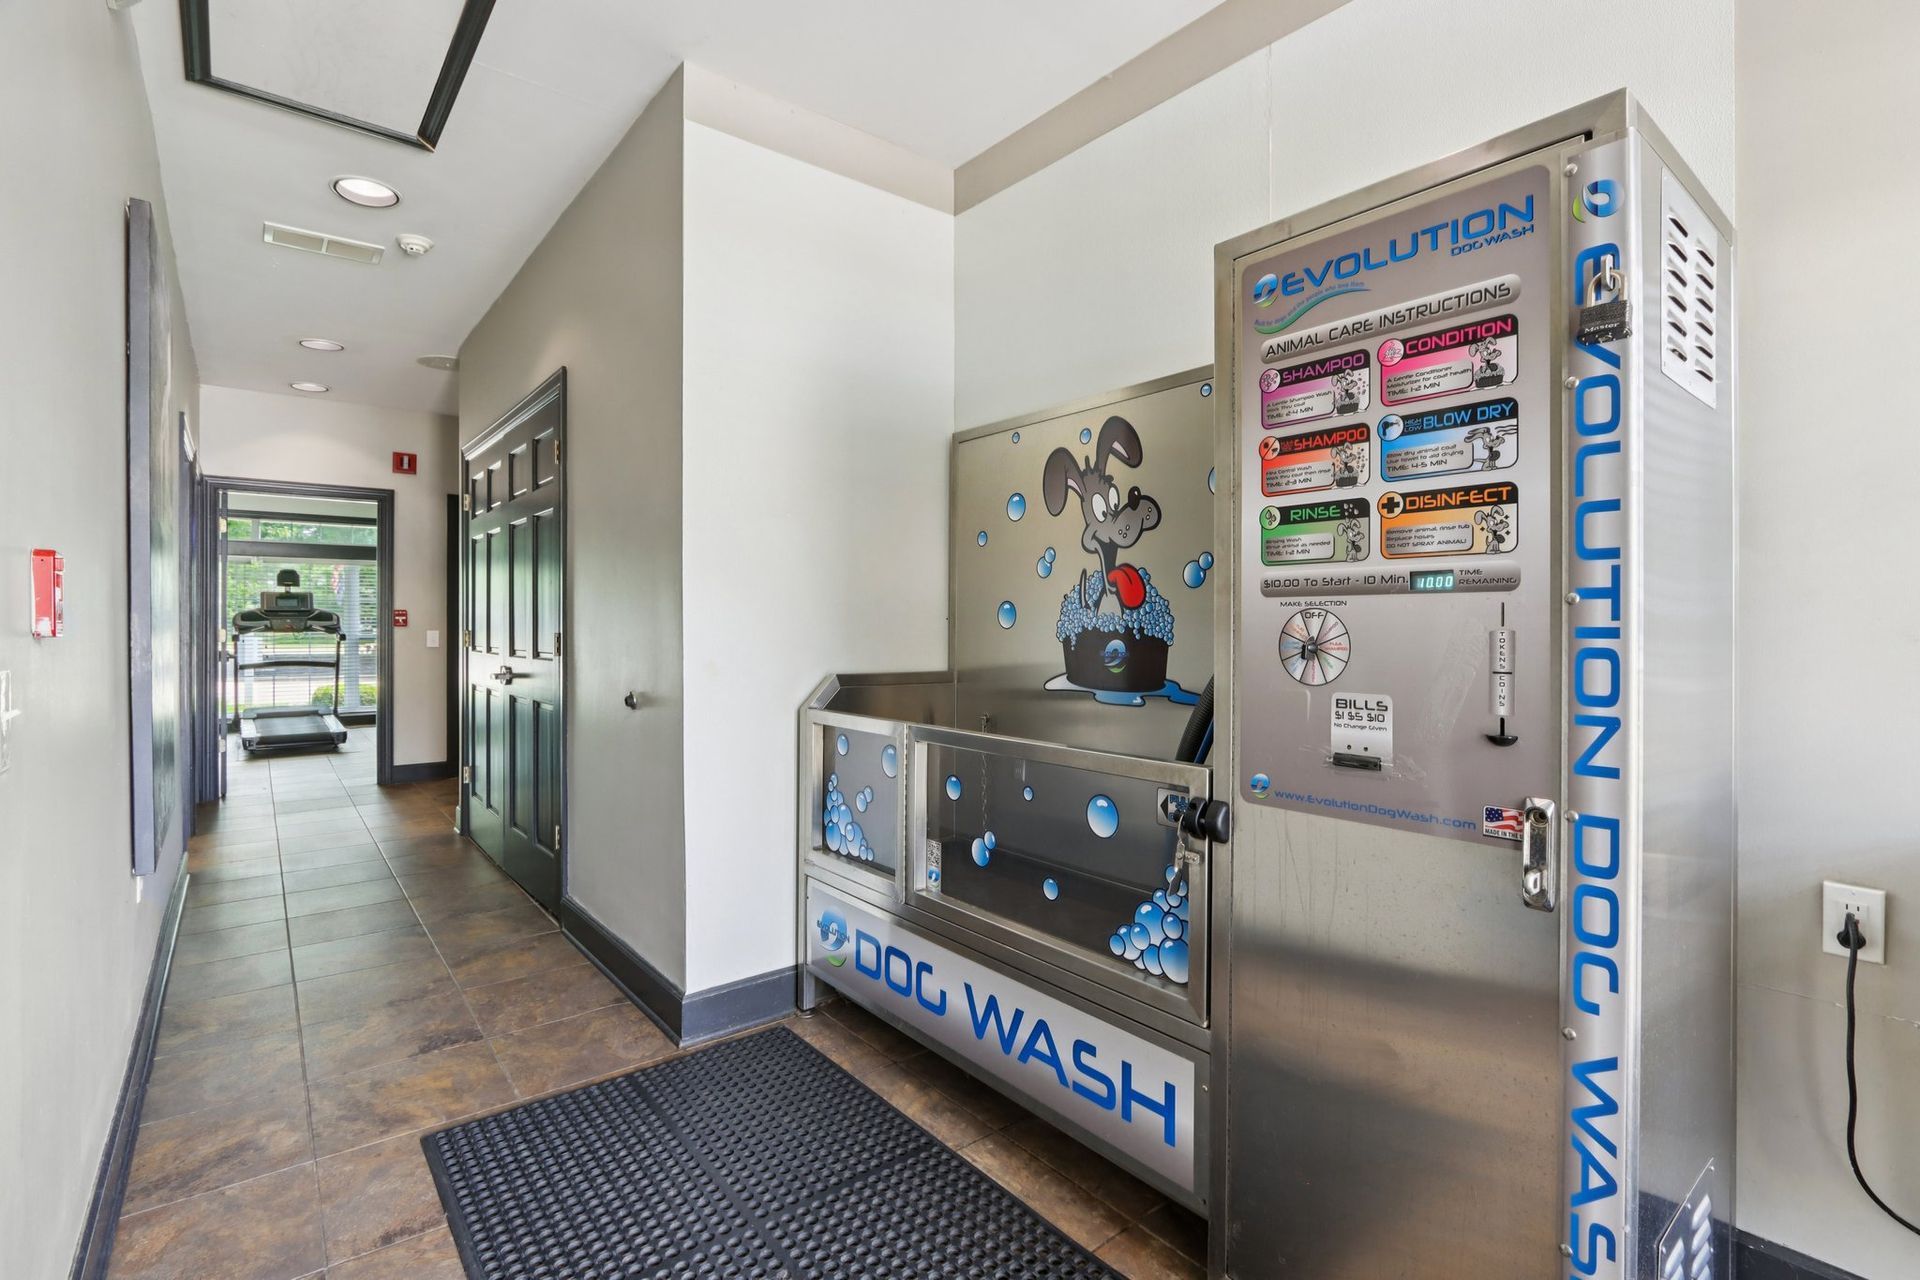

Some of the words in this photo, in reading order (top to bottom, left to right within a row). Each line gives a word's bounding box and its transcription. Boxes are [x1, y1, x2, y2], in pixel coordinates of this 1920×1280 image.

[1281, 194, 1534, 296] EVOLUTION
[1451, 240, 1482, 257] DOG
[1482, 223, 1534, 247] WASH
[1265, 332, 1323, 358] ANIMAL
[1328, 319, 1373, 341] CARE
[1379, 282, 1512, 329] INSTRUCTIONS
[1584, 321, 1621, 334] Master
[1406, 318, 1512, 354] CONDITION
[1282, 353, 1365, 383] SHAMPOO
[1415, 366, 1453, 377] Conditioner
[1432, 372, 1448, 380] coat
[1423, 381, 1441, 390] MIN
[1299, 406, 1314, 414] MIN
[1423, 409, 1472, 430] BLOW
[1477, 402, 1514, 420] DRY
[1294, 428, 1367, 450] SHAMPOO
[1387, 464, 1409, 472] TIME:
[1430, 459, 1448, 467] MIN
[1405, 486, 1512, 511] DISINFECT
[1290, 505, 1342, 522] RINSE
[1263, 578, 1300, 589] $10.00
[1303, 578, 1318, 587] To
[1321, 576, 1351, 586] Start
[1363, 575, 1377, 585] 10
[1380, 573, 1409, 585] Min.
[1458, 577, 1517, 586] REMAINING
[1459, 568, 1484, 576] TIME
[1304, 611, 1325, 619] OFF
[1498, 631, 1506, 670] TOKENS
[1498, 675, 1506, 707] COINS
[1335, 698, 1388, 712] BILLS
[1335, 710, 1345, 720] $1
[1347, 711, 1364, 722] $5
[1366, 713, 1386, 723] $10
[1274, 788, 1478, 831] www.EvolutionDogWash.com
[1485, 828, 1500, 836] MADE
[1573, 812, 1620, 1017] DOG
[855, 928, 947, 1017] DOG
[963, 981, 1177, 1149] WASH
[1570, 1056, 1619, 1280] WAS
